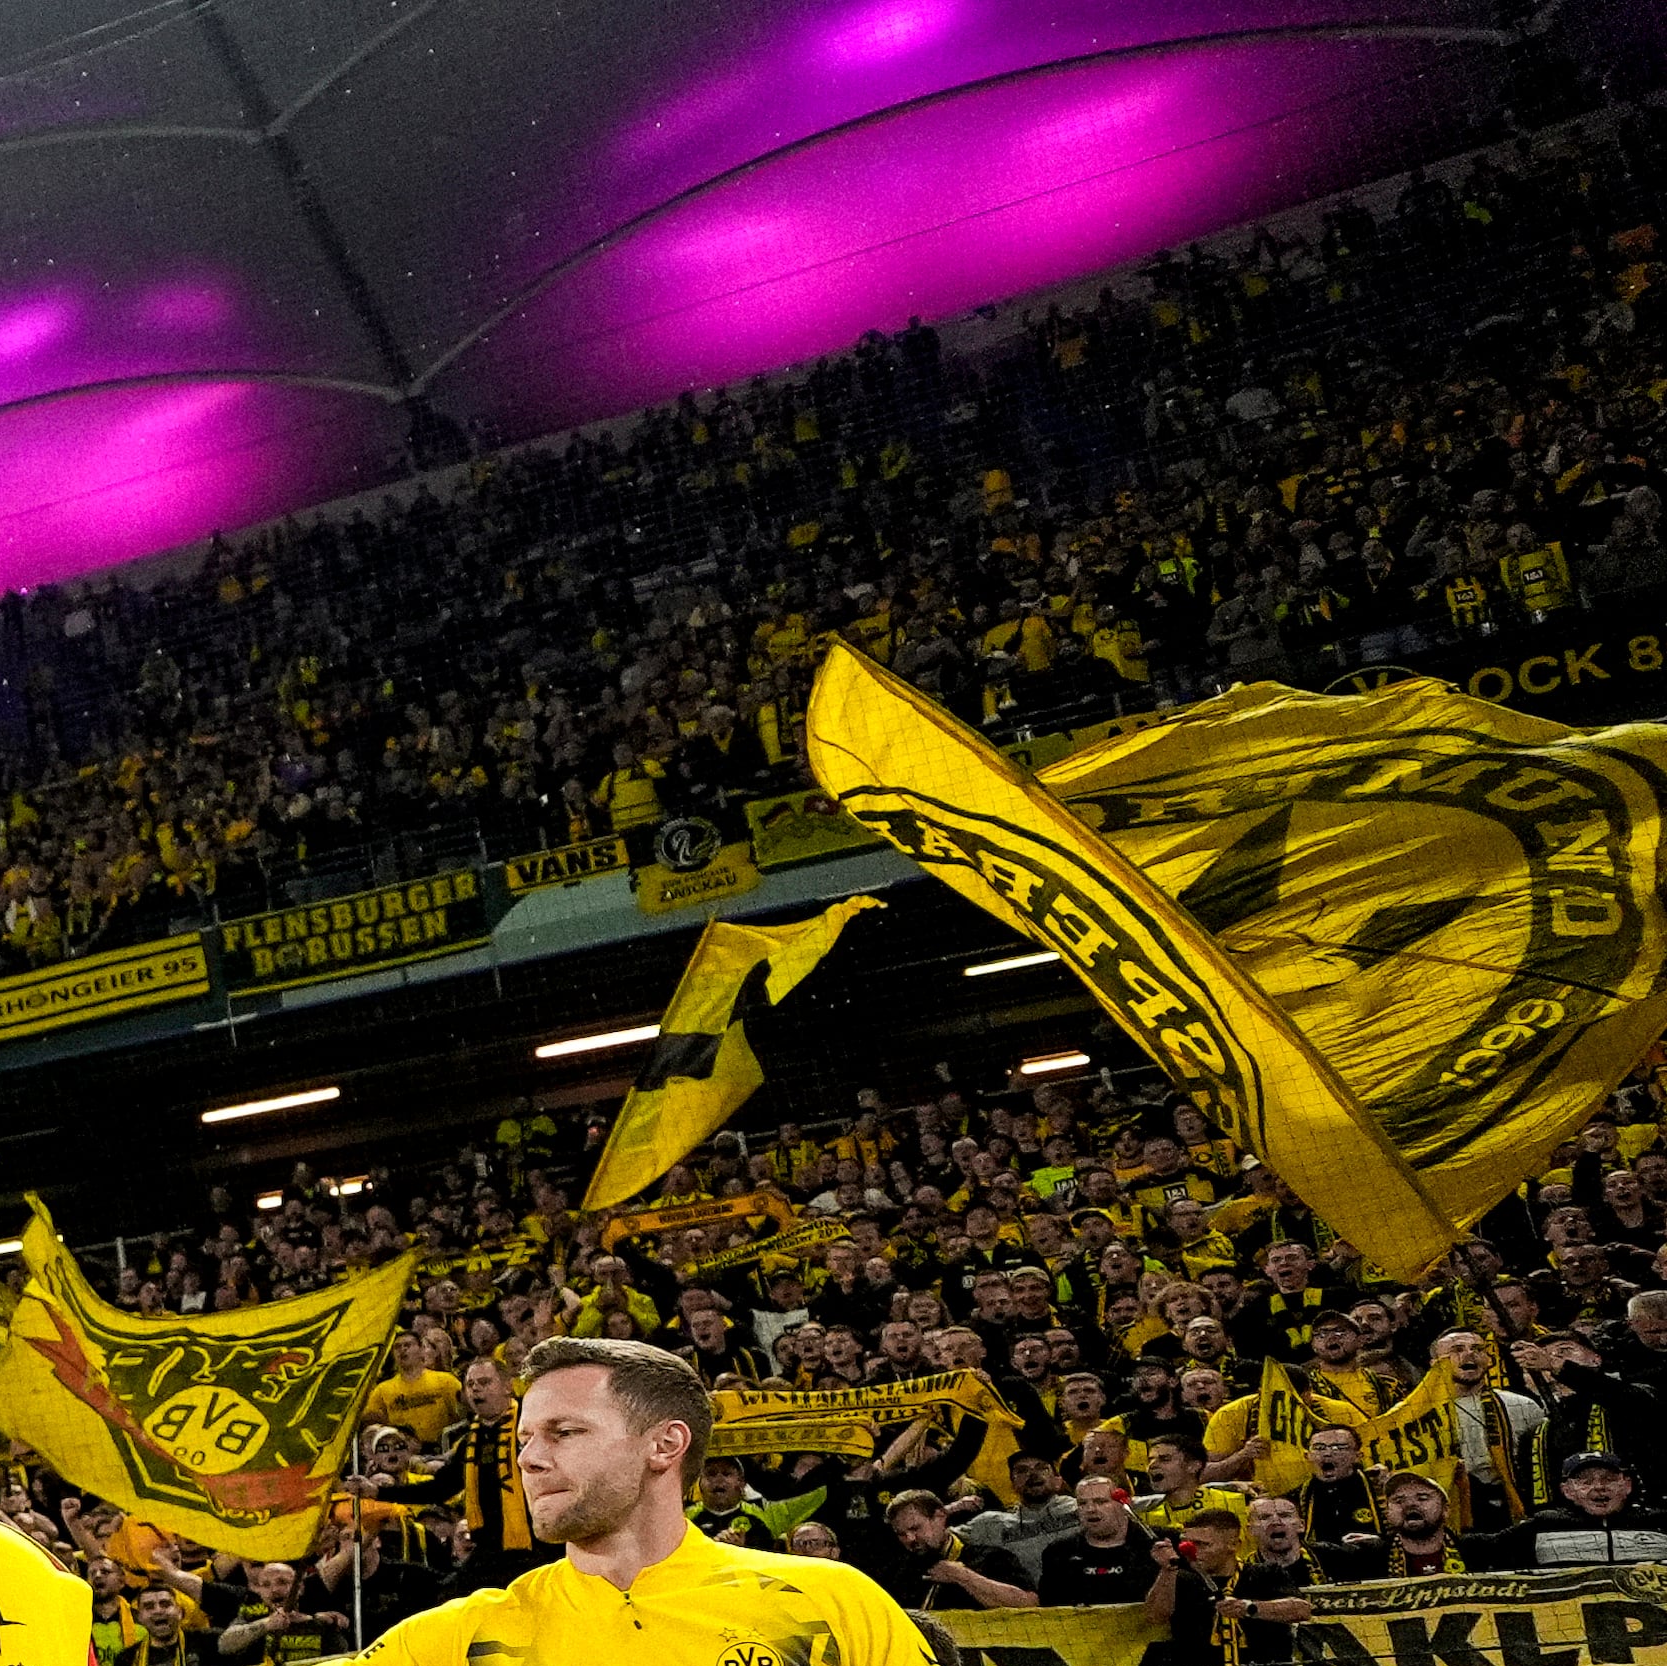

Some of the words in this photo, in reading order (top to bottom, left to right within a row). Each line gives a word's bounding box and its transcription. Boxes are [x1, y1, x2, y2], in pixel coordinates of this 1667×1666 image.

[1468, 642, 1612, 701] OCK
[515, 843, 618, 884] VANS
[163, 954, 199, 977] 95
[1382, 1580, 1531, 1611] Lippstadt
